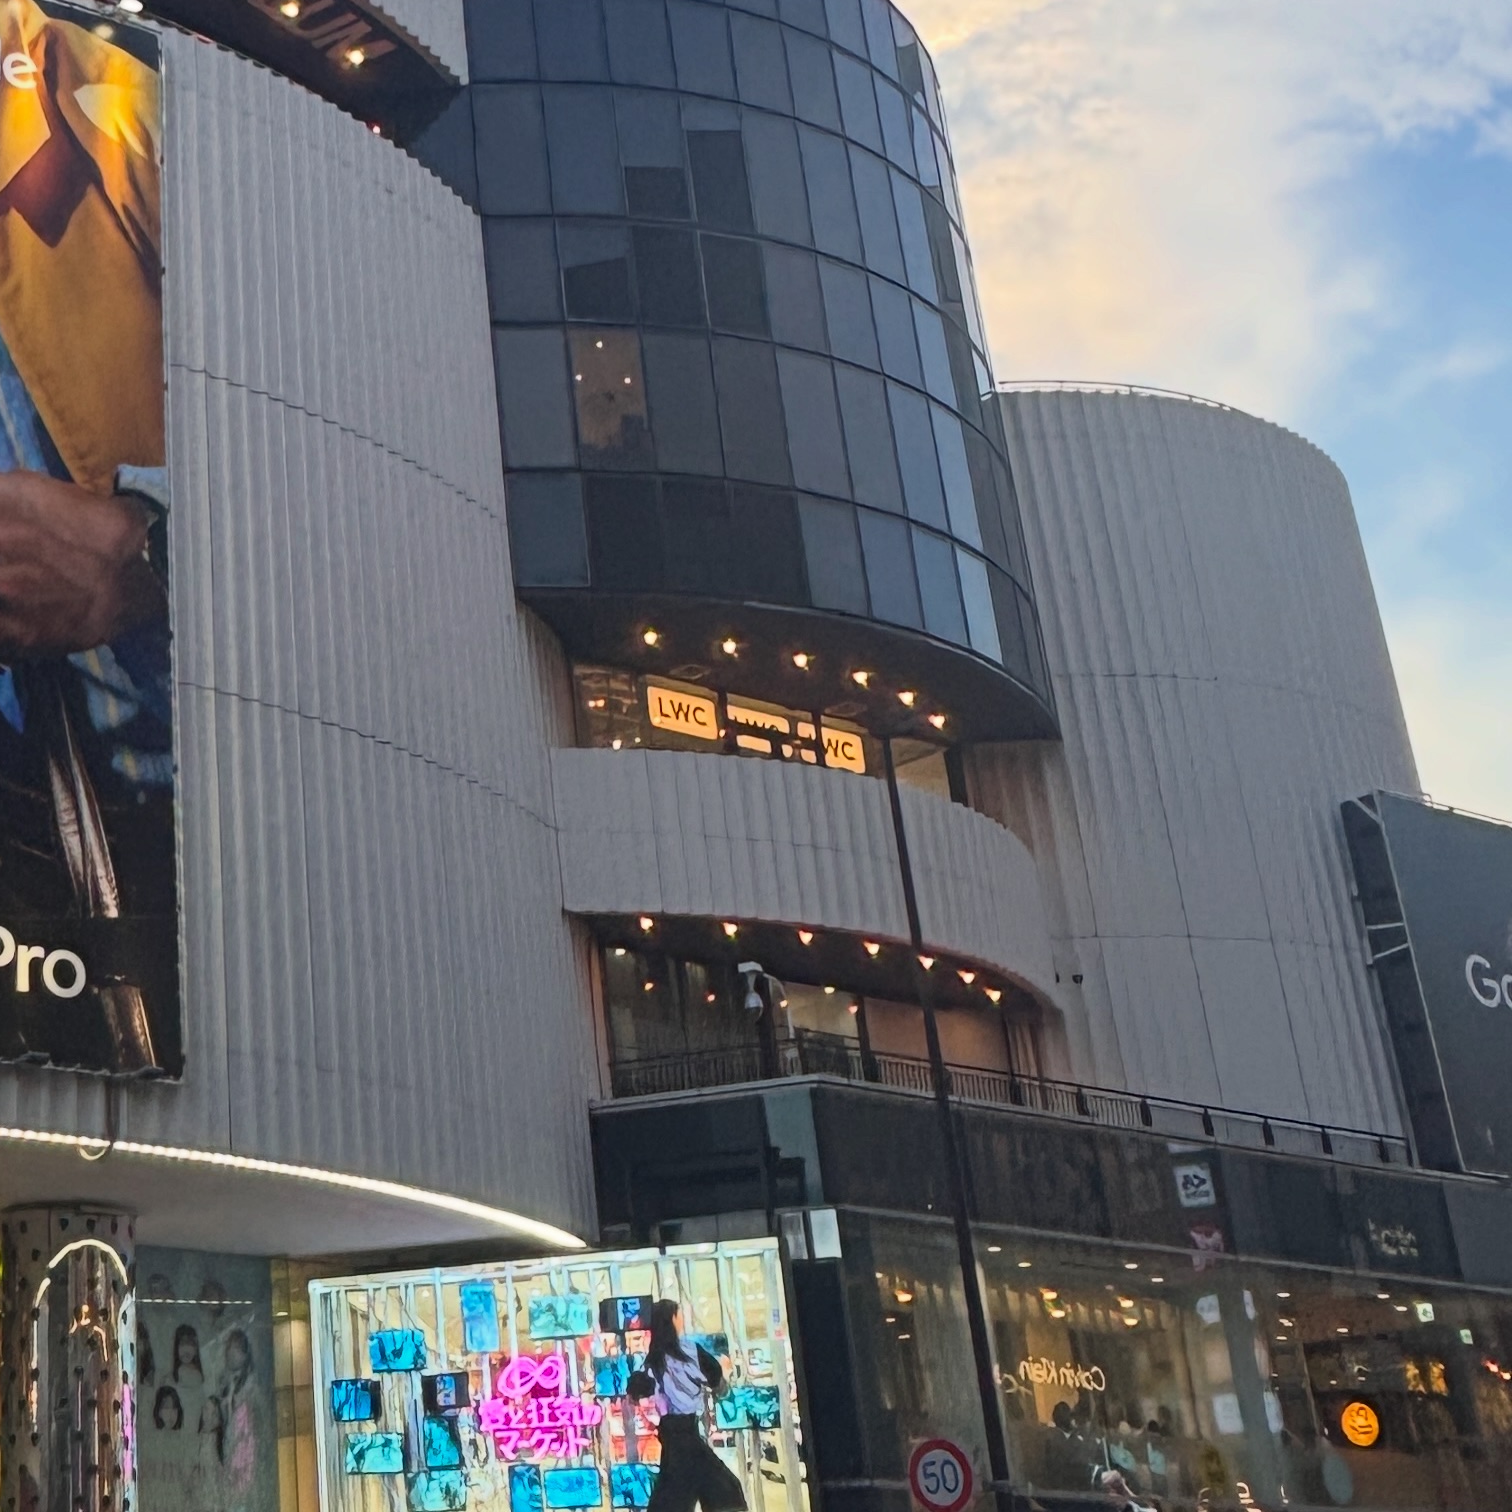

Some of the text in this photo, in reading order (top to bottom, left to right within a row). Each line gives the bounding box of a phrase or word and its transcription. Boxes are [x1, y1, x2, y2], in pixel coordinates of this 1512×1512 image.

[658, 697, 707, 726] LWC
[818, 737, 857, 762] WC
[921, 1459, 959, 1494] 50
